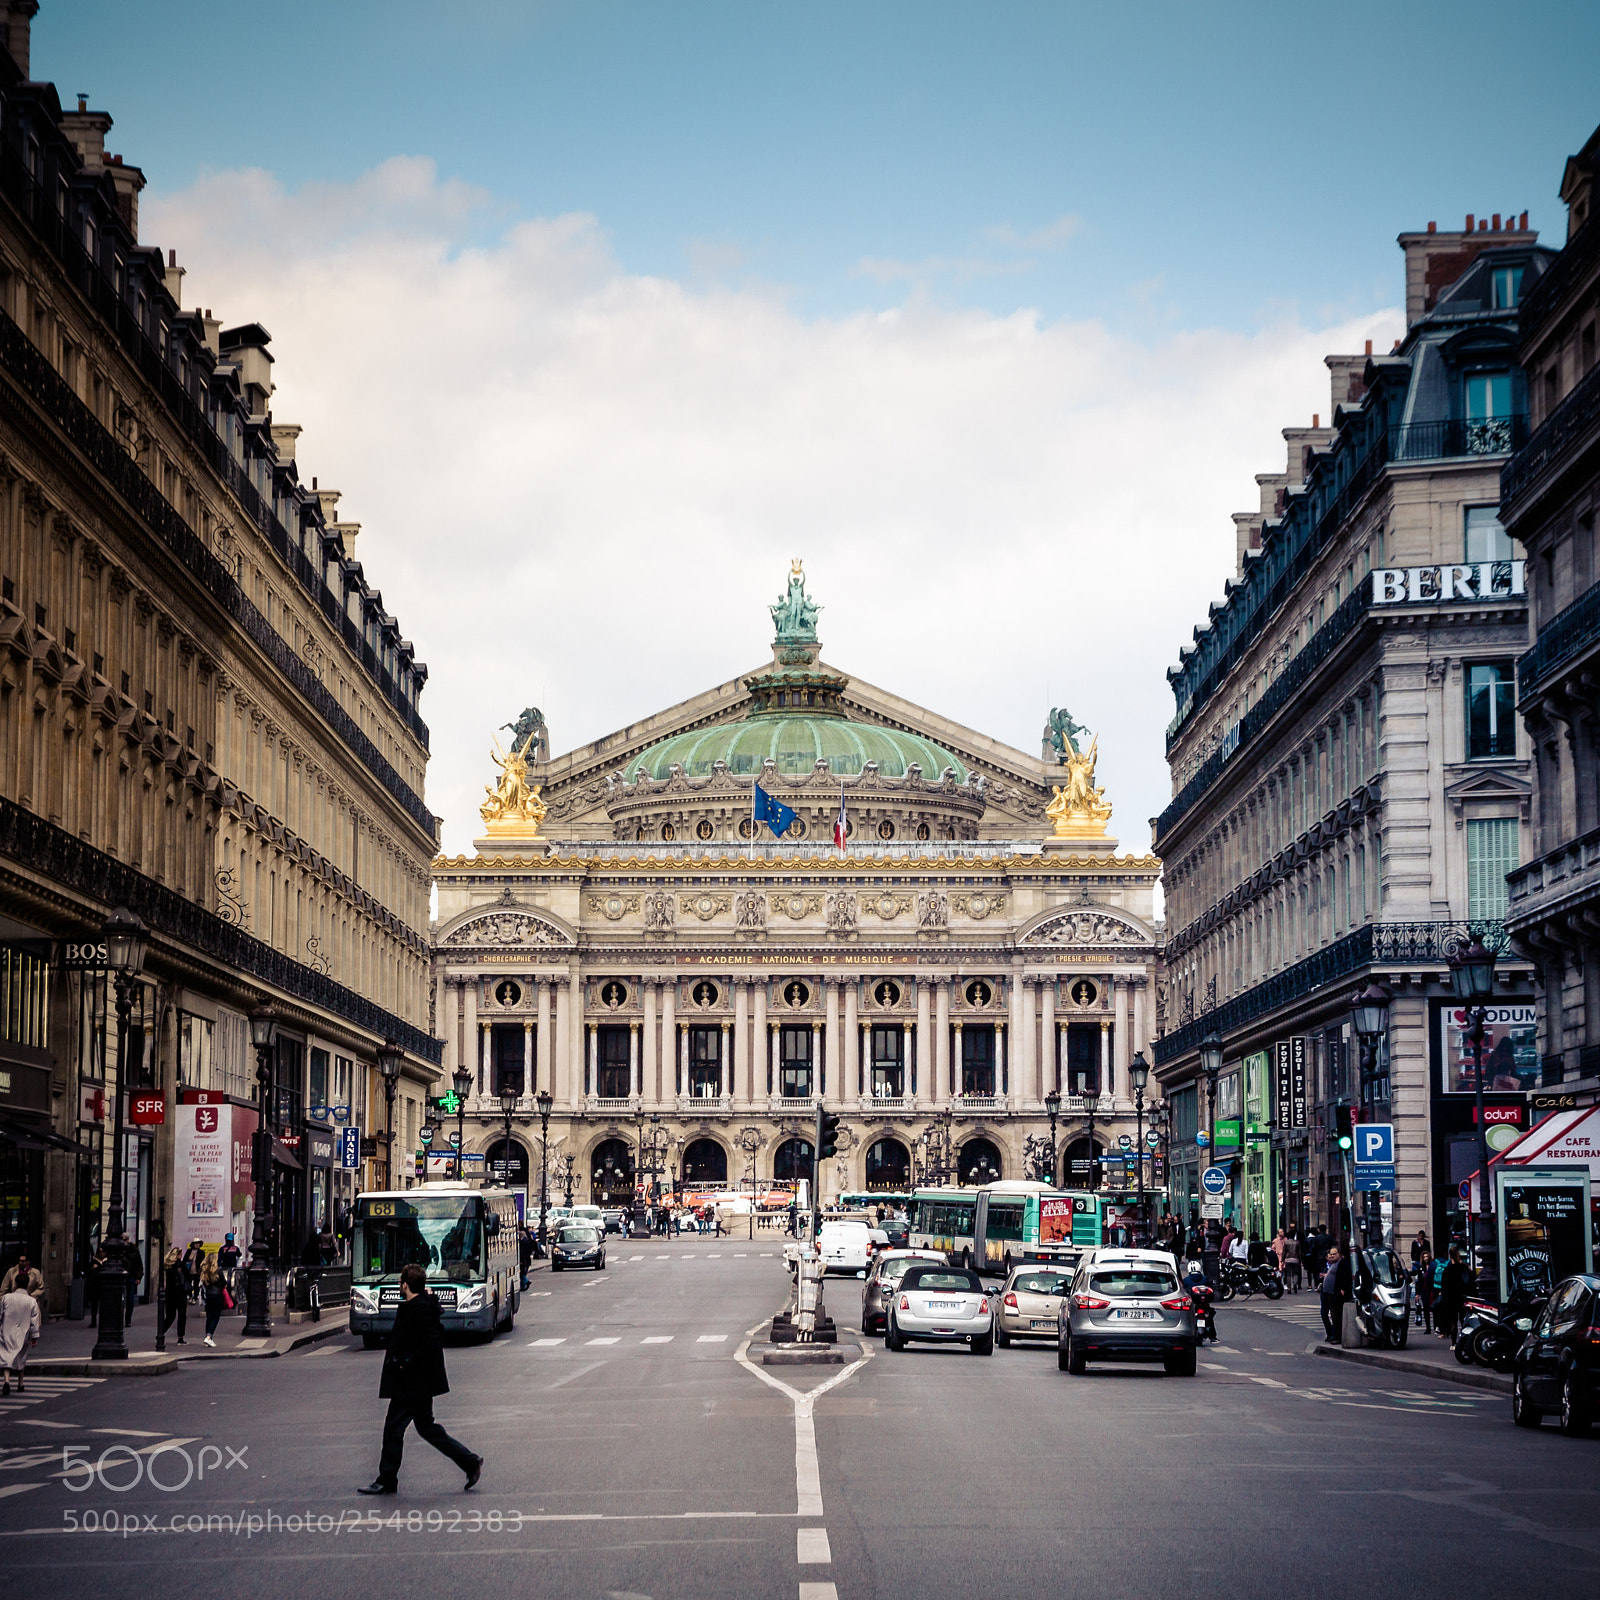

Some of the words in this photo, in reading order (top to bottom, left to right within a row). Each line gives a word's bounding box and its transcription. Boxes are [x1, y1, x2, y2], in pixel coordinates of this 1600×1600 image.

[1371, 561, 1526, 604] BERLI
[65, 944, 107, 959] BOS
[699, 956, 753, 964] ACADEMIE
[762, 956, 814, 964] NATIONALE
[822, 956, 837, 964] DE
[845, 956, 894, 965] MUSIQUE
[1475, 1009, 1536, 1022] ODUM
[1280, 1045, 1288, 1075] royal
[1295, 1039, 1303, 1071] royal
[1280, 1079, 1288, 1097] air
[1295, 1075, 1303, 1093] air
[136, 1101, 163, 1113] SFR
[1535, 1096, 1575, 1108] Café
[1279, 1101, 1290, 1128] maroc
[1294, 1097, 1305, 1125] maroc
[1483, 1108, 1518, 1120] odum
[421, 1129, 432, 1137] BUS
[1147, 1133, 1158, 1141] BUS
[345, 1129, 356, 1167] CHANGE
[1366, 1132, 1384, 1157] P
[1565, 1138, 1591, 1146] CAFE
[1546, 1149, 1600, 1158] RESTAURAN
[374, 1203, 393, 1215] 68
[1042, 1208, 1070, 1217] ELLES
